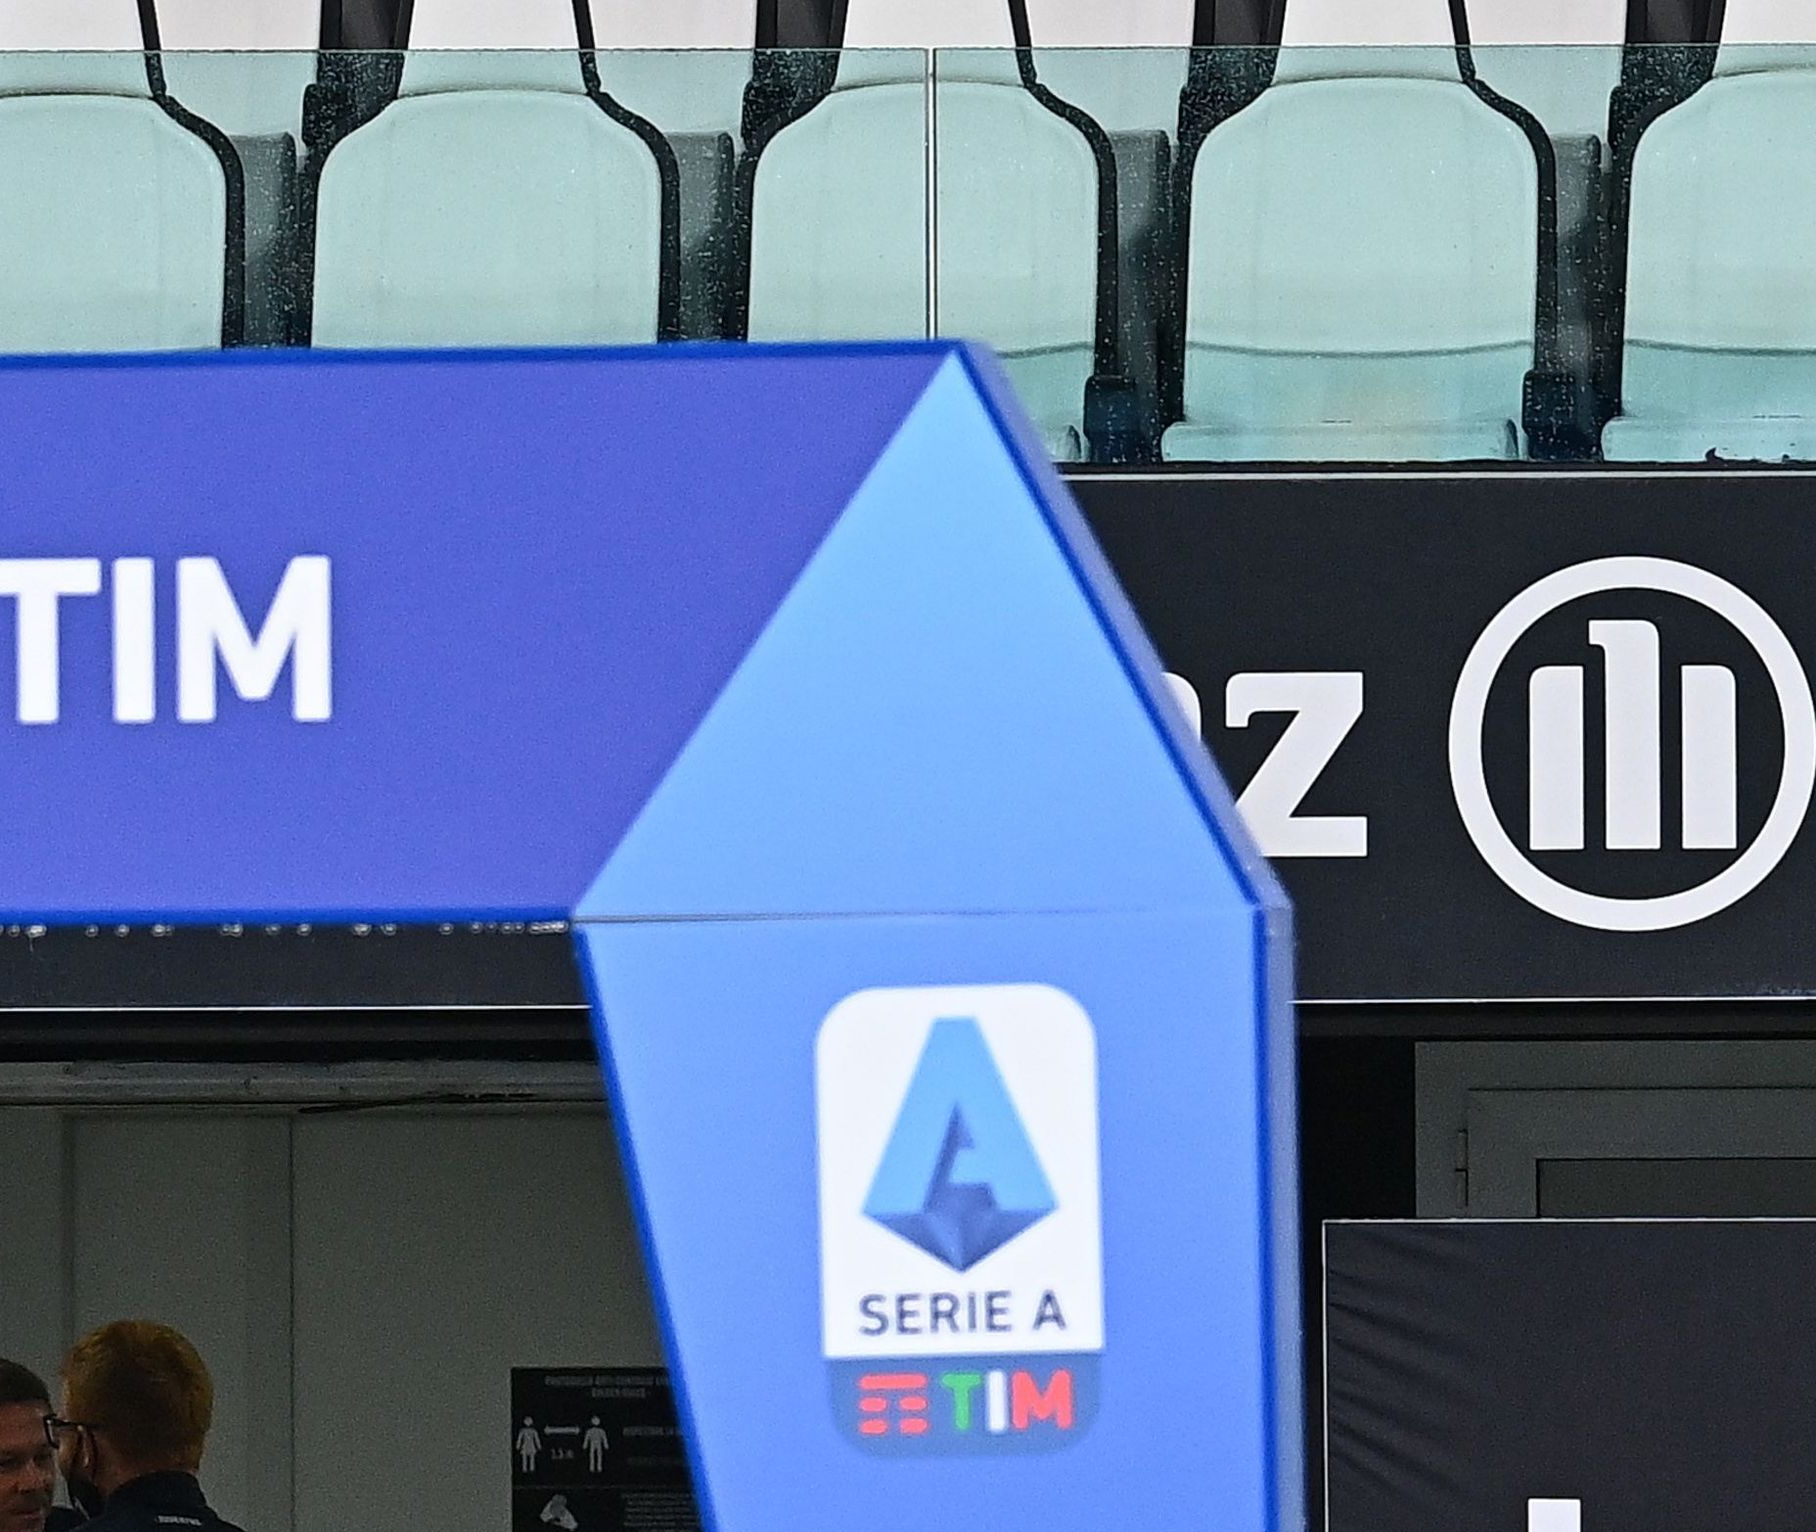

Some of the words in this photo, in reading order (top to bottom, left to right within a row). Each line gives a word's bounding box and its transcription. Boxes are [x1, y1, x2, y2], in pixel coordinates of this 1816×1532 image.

[858, 1290, 1012, 1336] SERIE
[1032, 1290, 1066, 1331] A
[939, 1369, 1073, 1433] TIM
